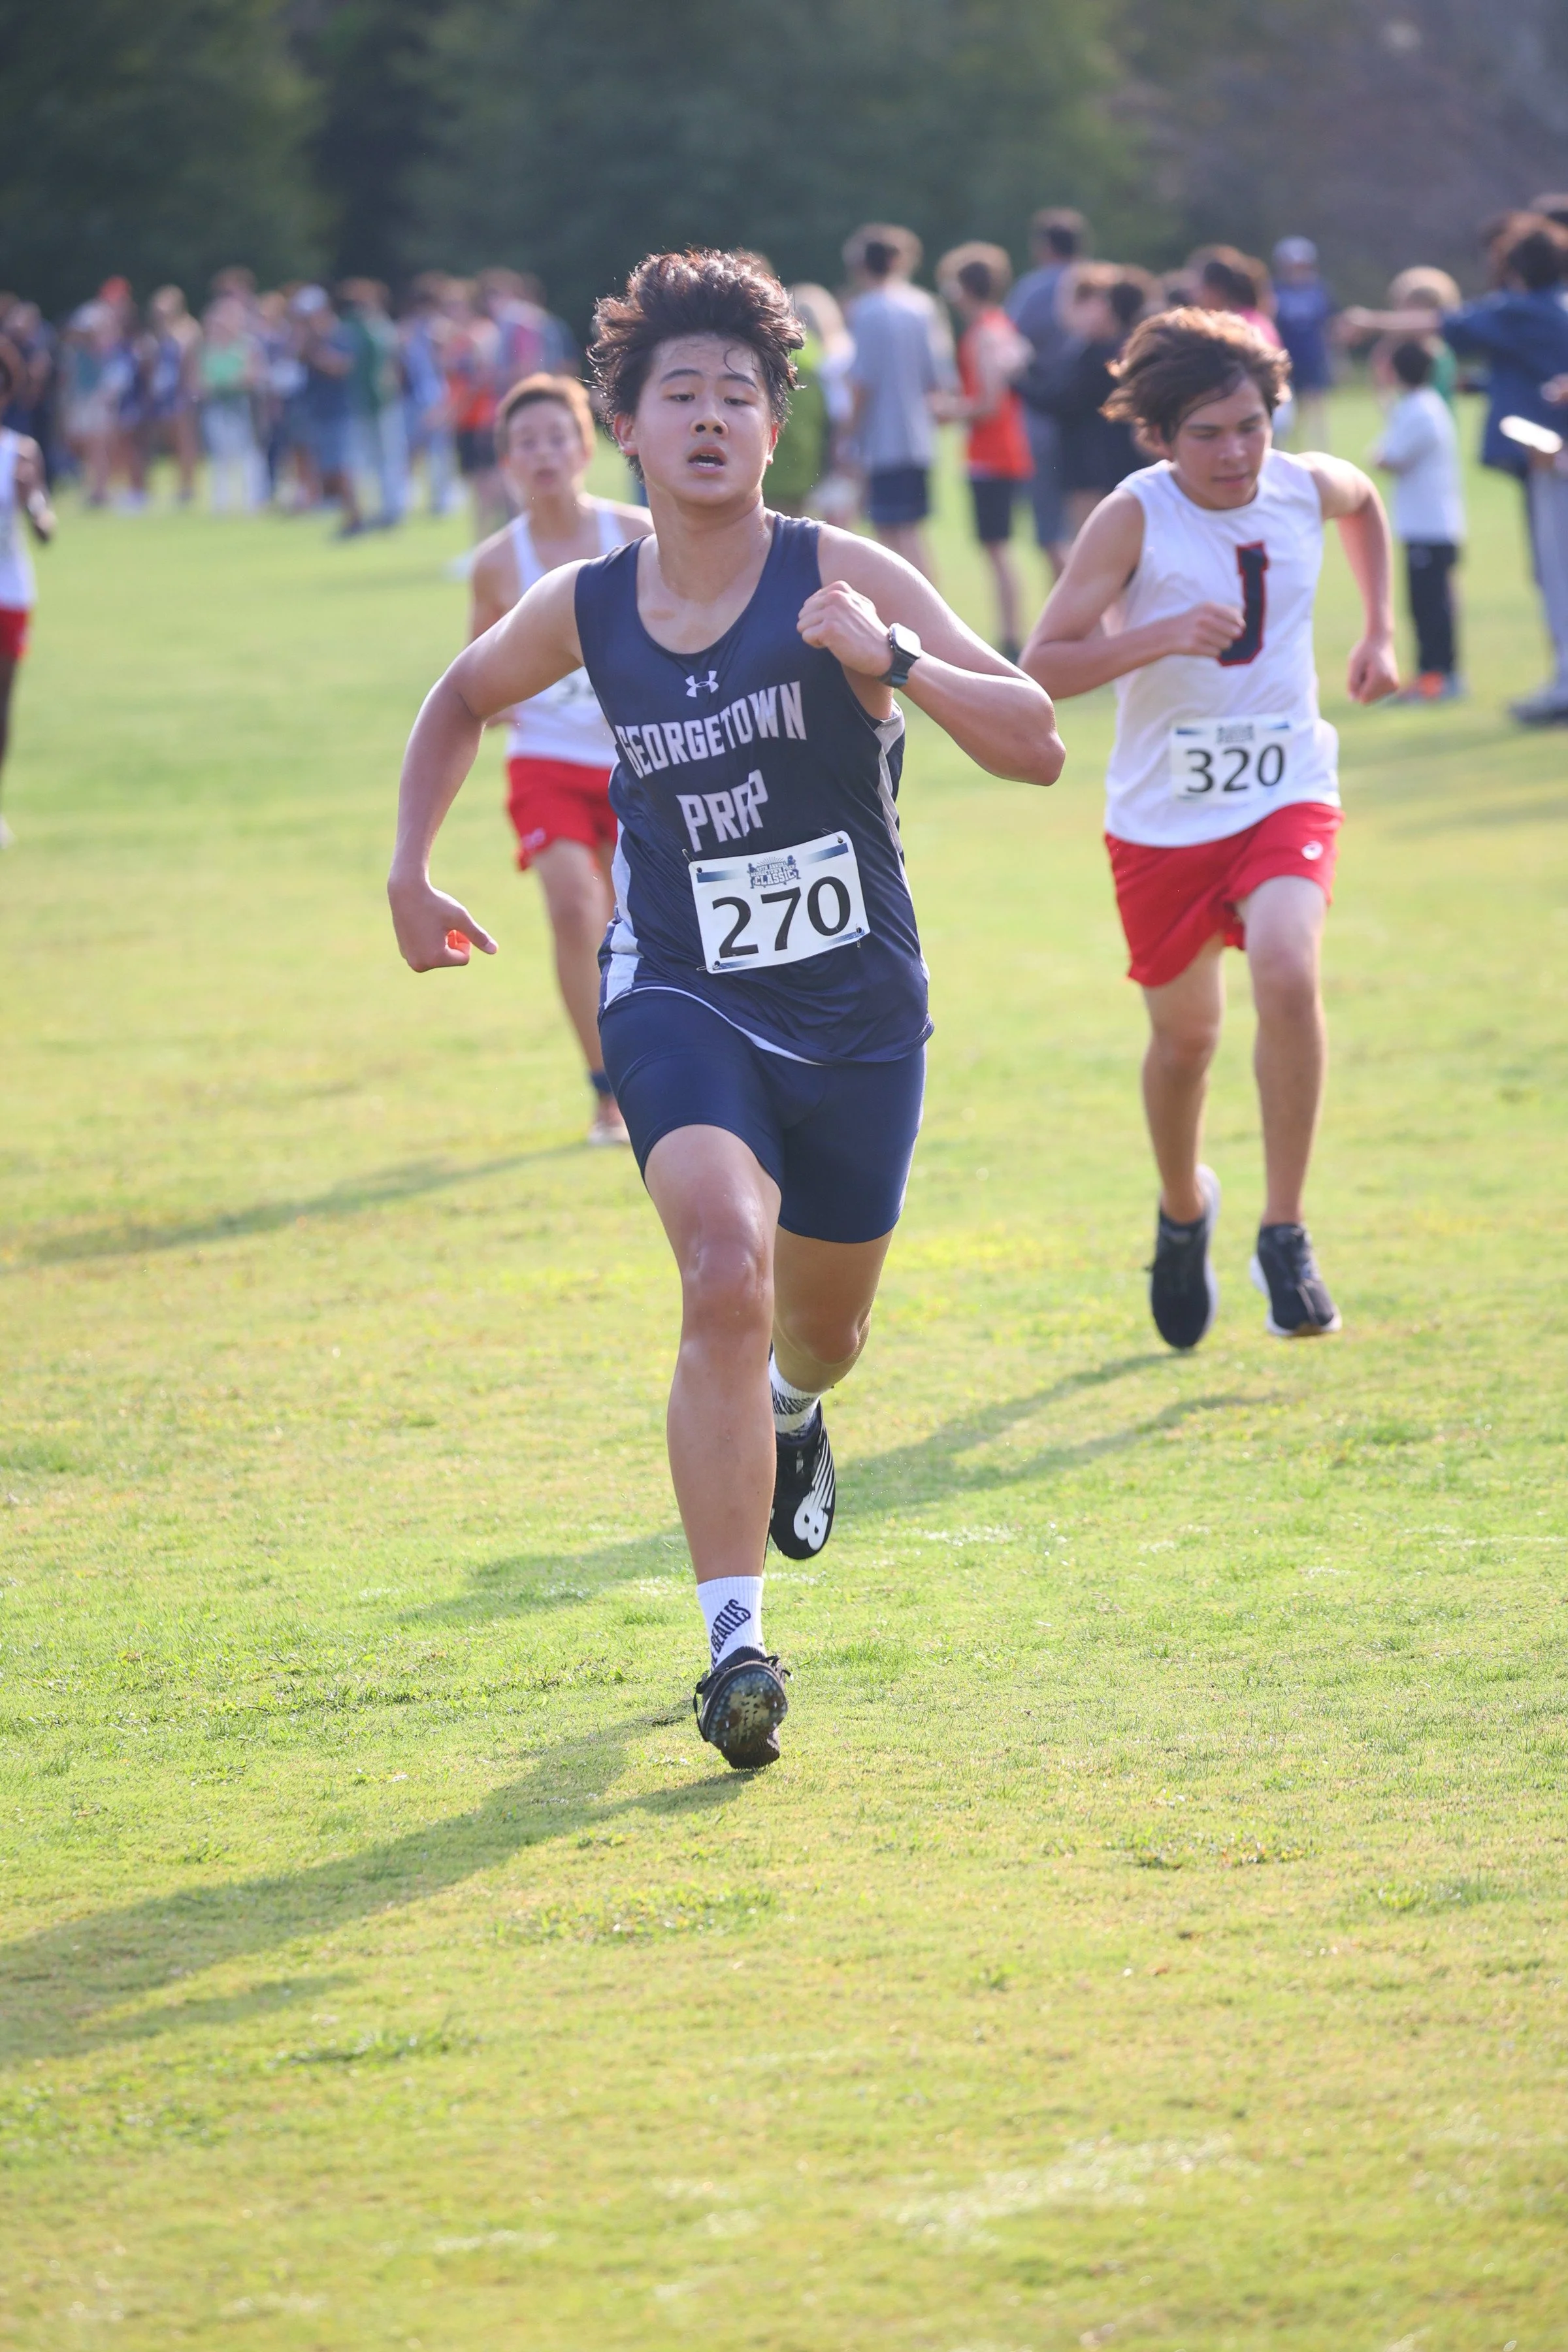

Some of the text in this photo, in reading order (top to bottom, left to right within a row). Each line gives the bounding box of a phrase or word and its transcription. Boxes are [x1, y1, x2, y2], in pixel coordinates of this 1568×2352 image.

[1216, 540, 1269, 667] J
[615, 680, 807, 779] GEORGETOWN
[1186, 742, 1286, 793] 320
[750, 868, 782, 877] GEORGETOWN
[755, 870, 795, 885] CLASSIC
[711, 875, 851, 958] 270
[710, 1599, 751, 1654] BEATLES
